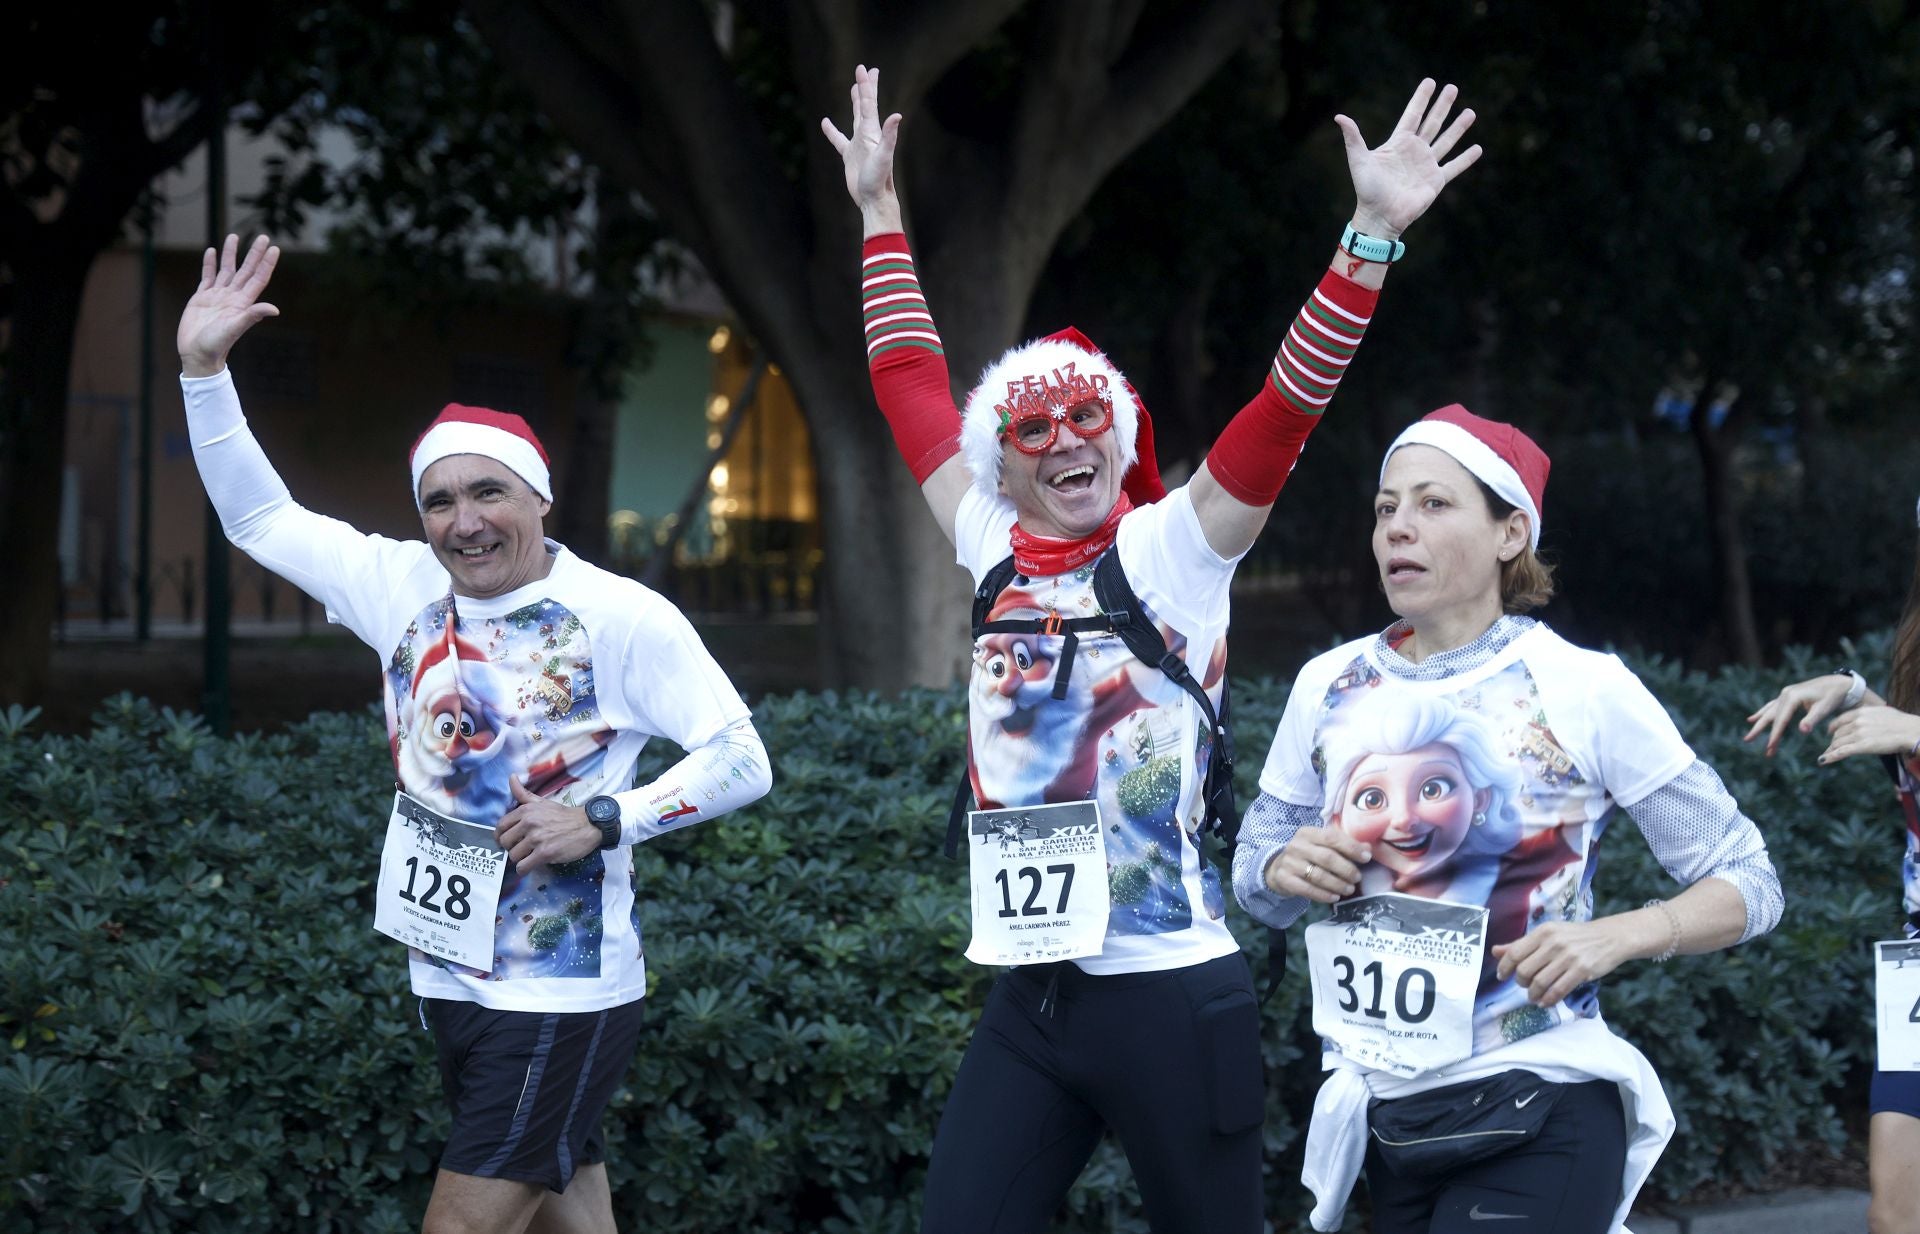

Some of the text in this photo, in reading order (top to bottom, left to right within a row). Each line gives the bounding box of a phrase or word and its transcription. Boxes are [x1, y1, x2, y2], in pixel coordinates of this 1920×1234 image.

[1007, 361, 1076, 399] FELIZ
[993, 373, 1109, 417] NAVIDAD
[1042, 835, 1095, 846] CARRERA
[1049, 824, 1097, 838] XIV
[456, 842, 503, 859] XIV
[1038, 846, 1096, 856] PALMILLA
[1040, 841, 1095, 851] SILVESTRE
[416, 844, 439, 860] PALMA
[443, 858, 495, 875] PALMILLA
[430, 846, 443, 856] SAN
[446, 853, 496, 871] SILVESTRE
[449, 849, 497, 866] CARRERA
[398, 856, 471, 921] 128
[995, 863, 1075, 918] 127
[1404, 936, 1473, 952] CARRERA
[1420, 926, 1480, 944] XIV
[1345, 939, 1386, 950] PALMA
[1394, 947, 1471, 964] PALMILLA
[1367, 936, 1393, 945] SAN
[1398, 942, 1472, 958] SILVESTRE
[1333, 955, 1436, 1024] 310
[1416, 1032, 1438, 1040] ROTA
